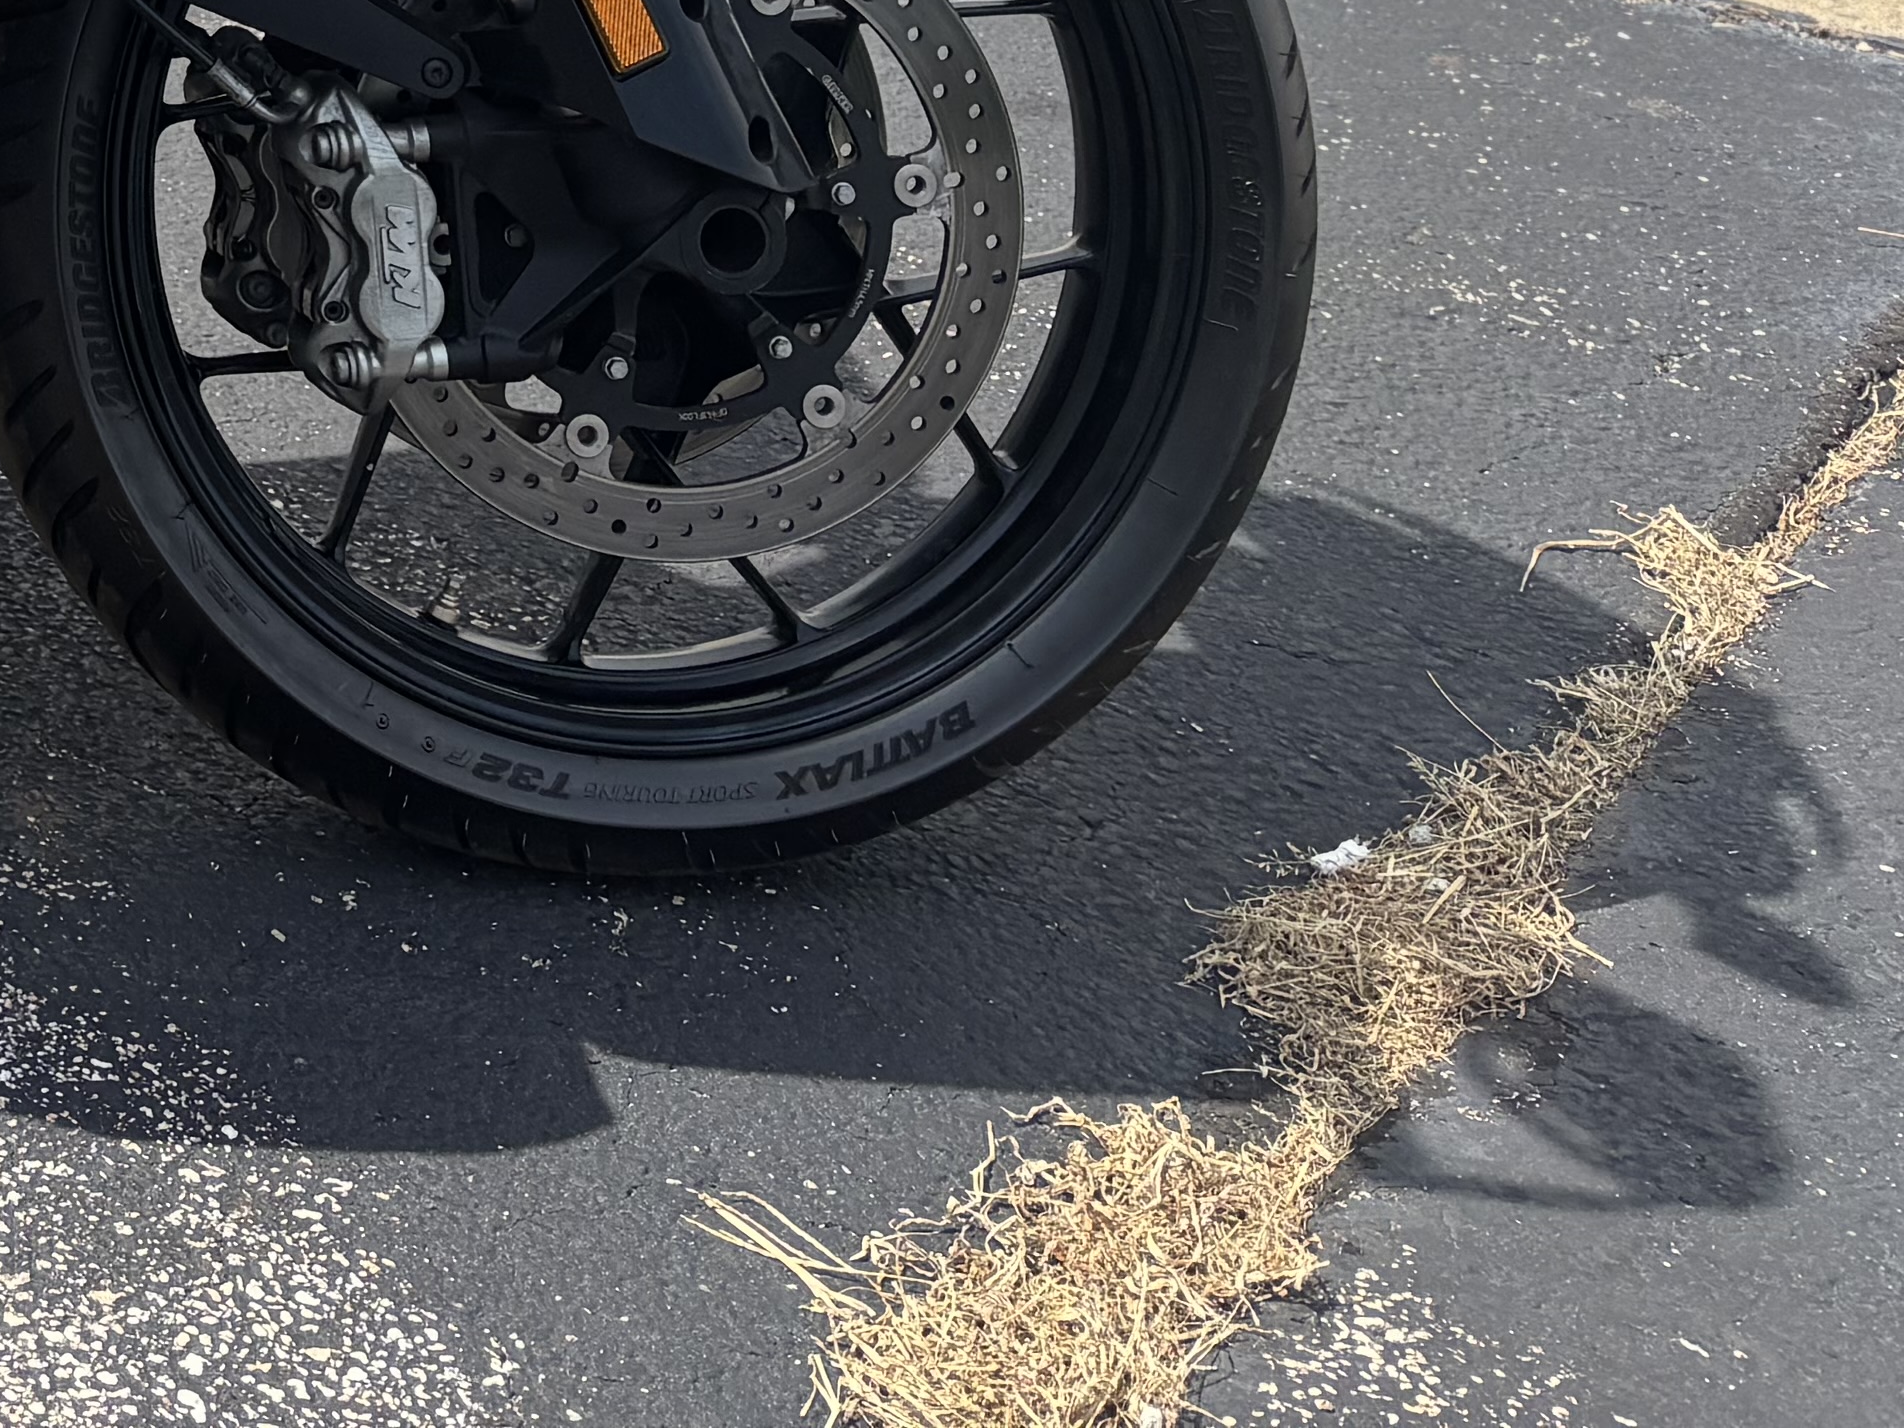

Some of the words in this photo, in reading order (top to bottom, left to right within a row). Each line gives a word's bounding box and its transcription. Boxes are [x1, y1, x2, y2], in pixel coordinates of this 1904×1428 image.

[68, 96, 133, 408] BRIDGESTONE
[379, 204, 422, 310] KTM
[700, 780, 759, 803] SPORT
[774, 700, 975, 801] BATTLAX
